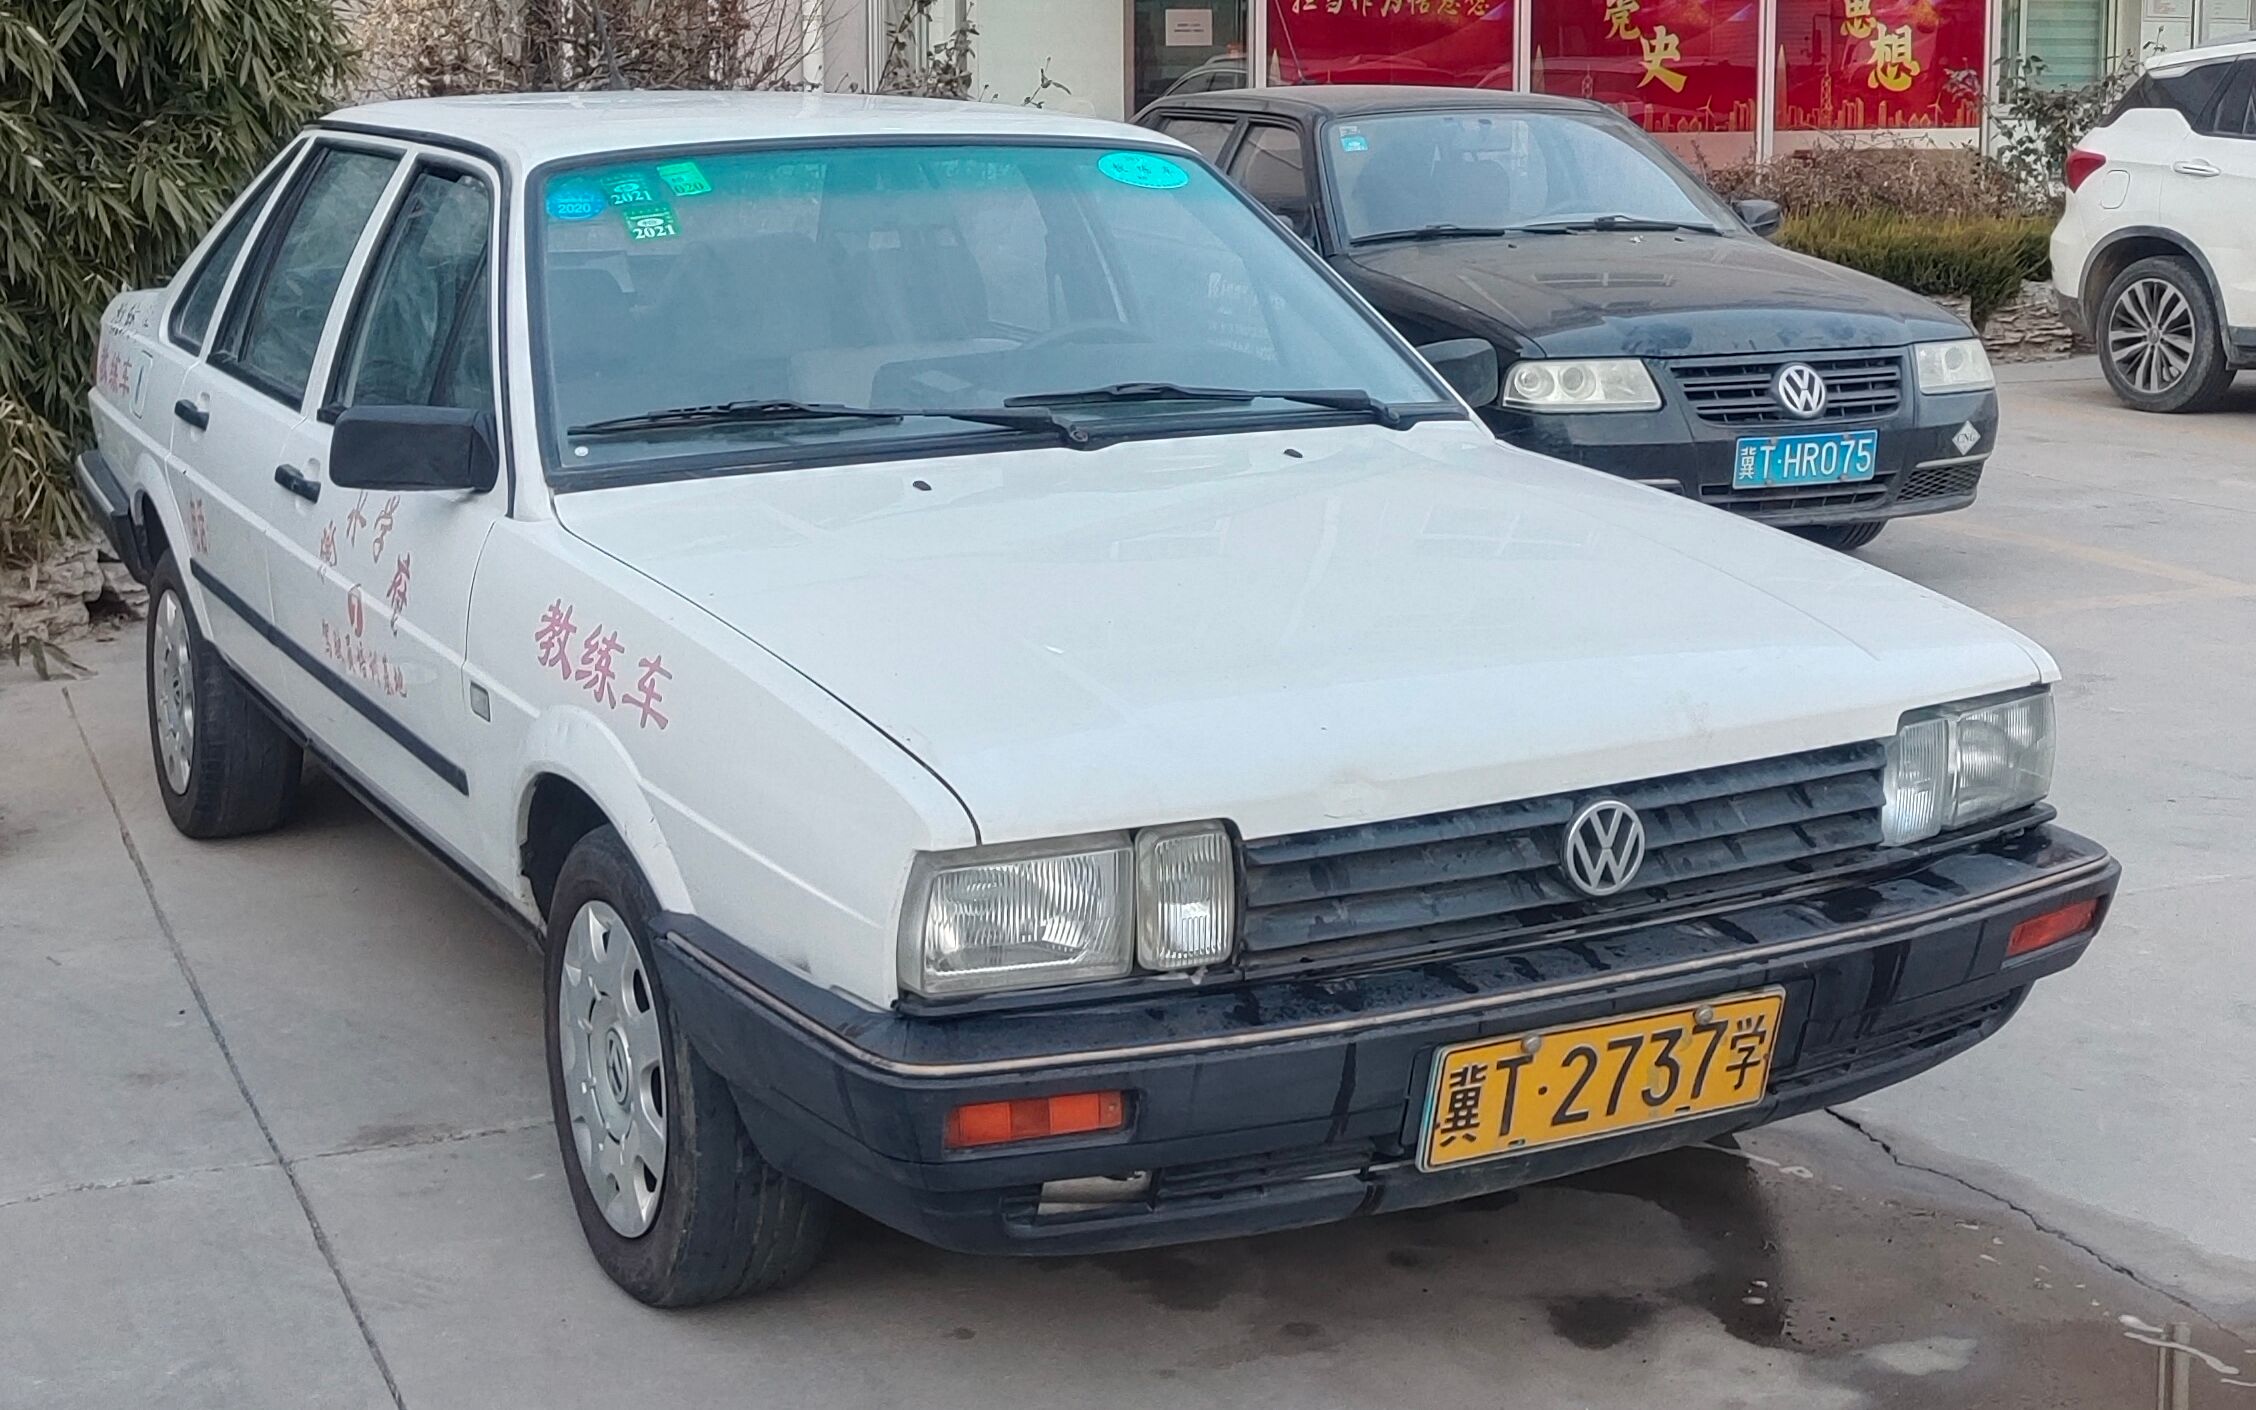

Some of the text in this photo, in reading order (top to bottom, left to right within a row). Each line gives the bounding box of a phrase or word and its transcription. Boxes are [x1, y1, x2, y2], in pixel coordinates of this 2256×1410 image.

[1839, 0, 1921, 92] 思想
[610, 190, 653, 205] 2021
[558, 202, 592, 214] 2020
[632, 224, 676, 240] 2021
[534, 598, 674, 731] 教练车
